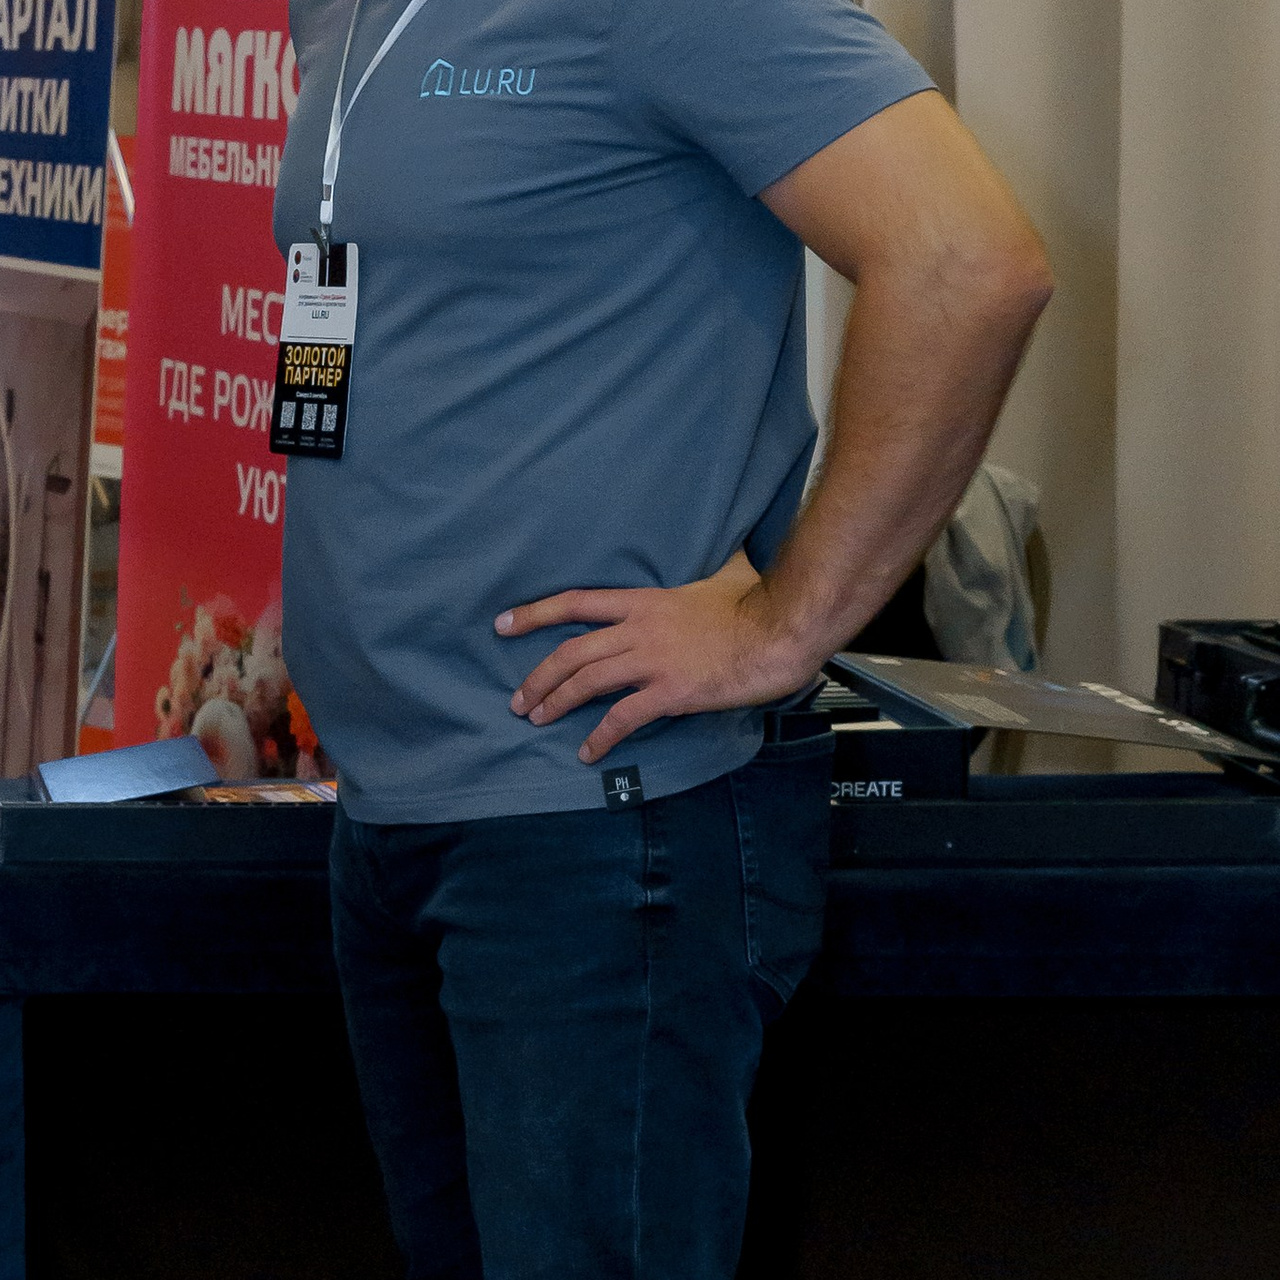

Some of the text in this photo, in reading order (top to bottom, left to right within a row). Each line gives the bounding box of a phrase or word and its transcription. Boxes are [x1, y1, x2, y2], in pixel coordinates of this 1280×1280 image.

[459, 67, 536, 96] LU.RU
[284, 344, 346, 367] ЗОЛОТОЙ
[159, 358, 206, 424] ГДЕ
[284, 366, 343, 387] ПАРТНЕР
[236, 463, 287, 525] УЮ
